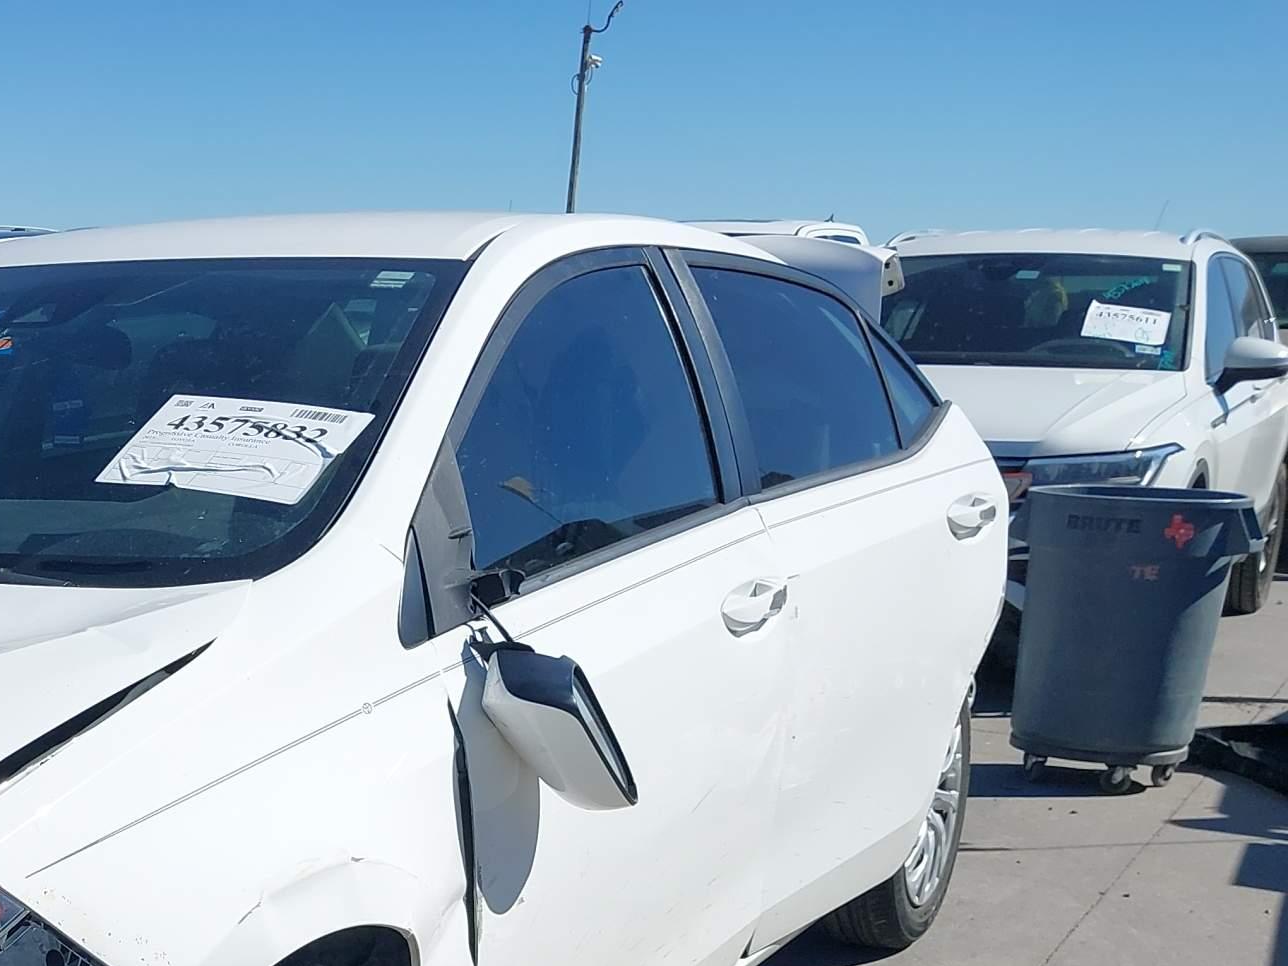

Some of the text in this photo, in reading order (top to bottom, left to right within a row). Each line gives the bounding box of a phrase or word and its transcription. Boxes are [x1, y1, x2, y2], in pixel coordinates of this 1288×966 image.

[147, 429, 193, 439] Progressive
[194, 433, 229, 442] Casualty
[230, 436, 272, 445] Insurance
[166, 414, 329, 443] 43575832
[1066, 514, 1143, 534] BRUTE
